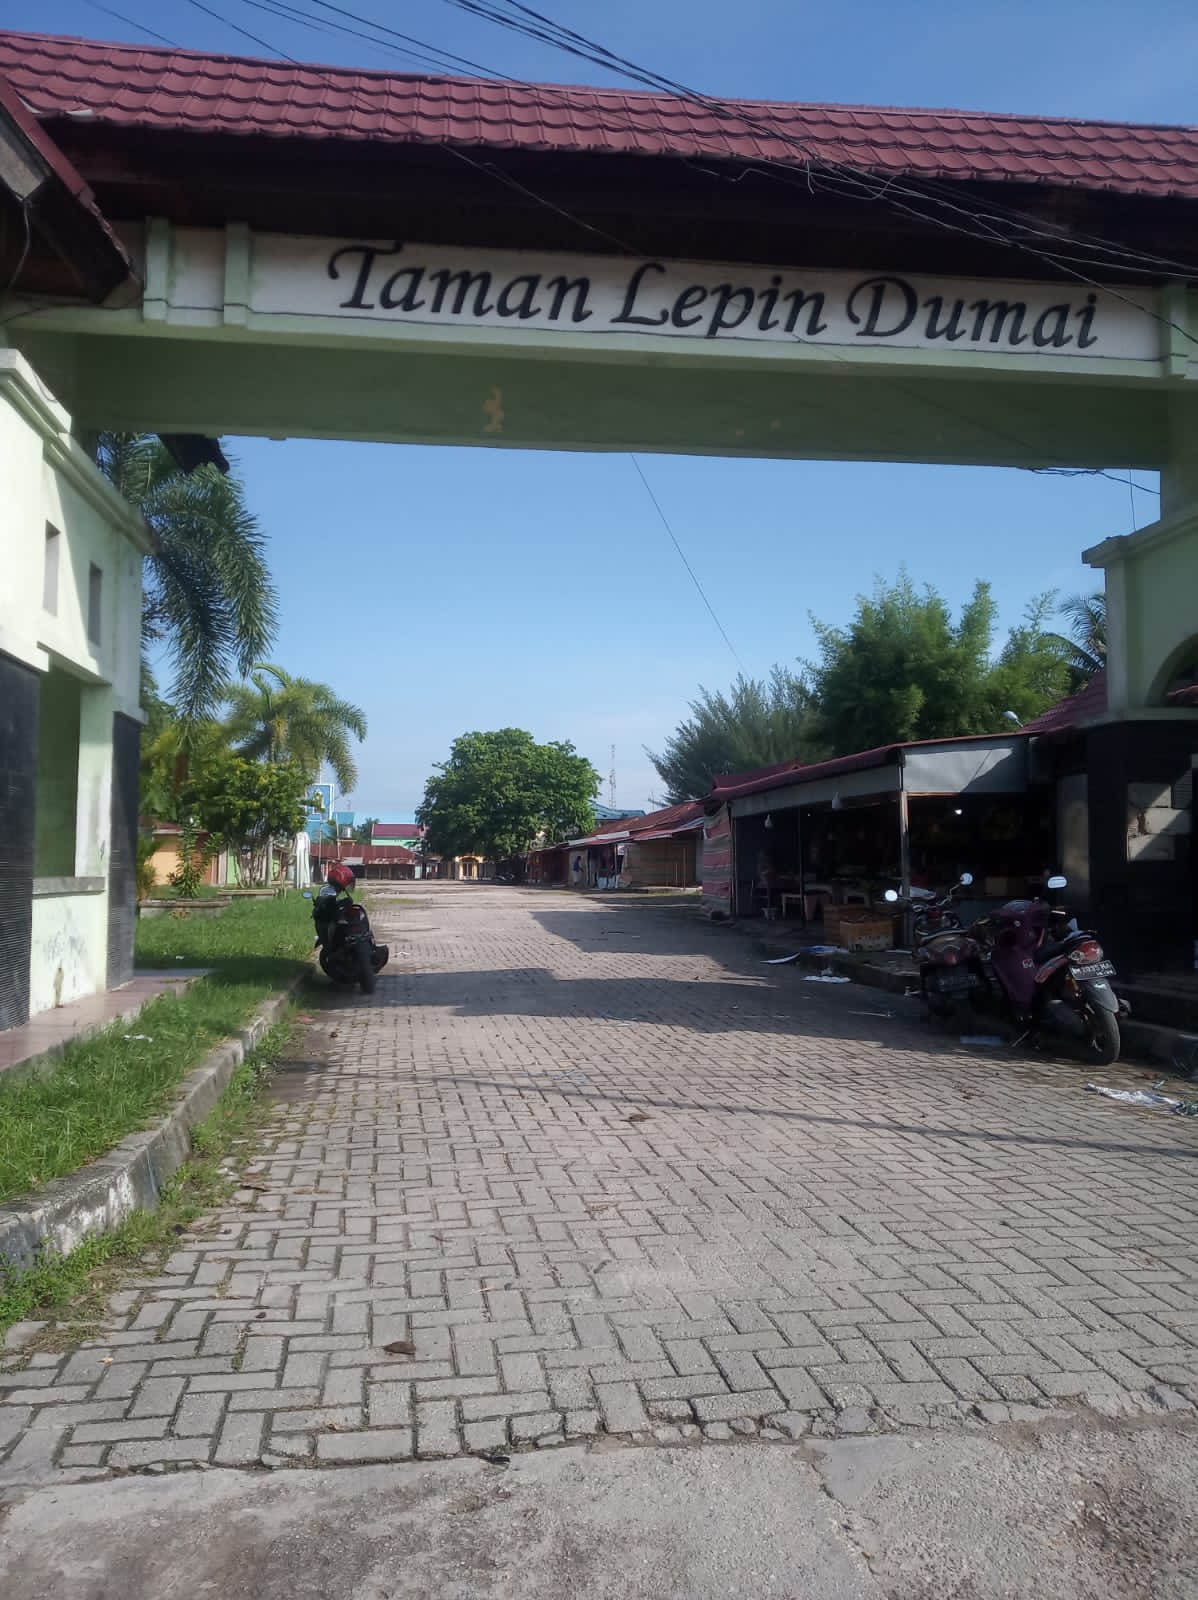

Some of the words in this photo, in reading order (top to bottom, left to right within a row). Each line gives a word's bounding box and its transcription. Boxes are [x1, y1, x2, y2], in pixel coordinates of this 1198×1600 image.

[327, 241, 593, 323] Taman
[610, 261, 828, 340] Lepin
[846, 276, 1099, 350] Dumai
